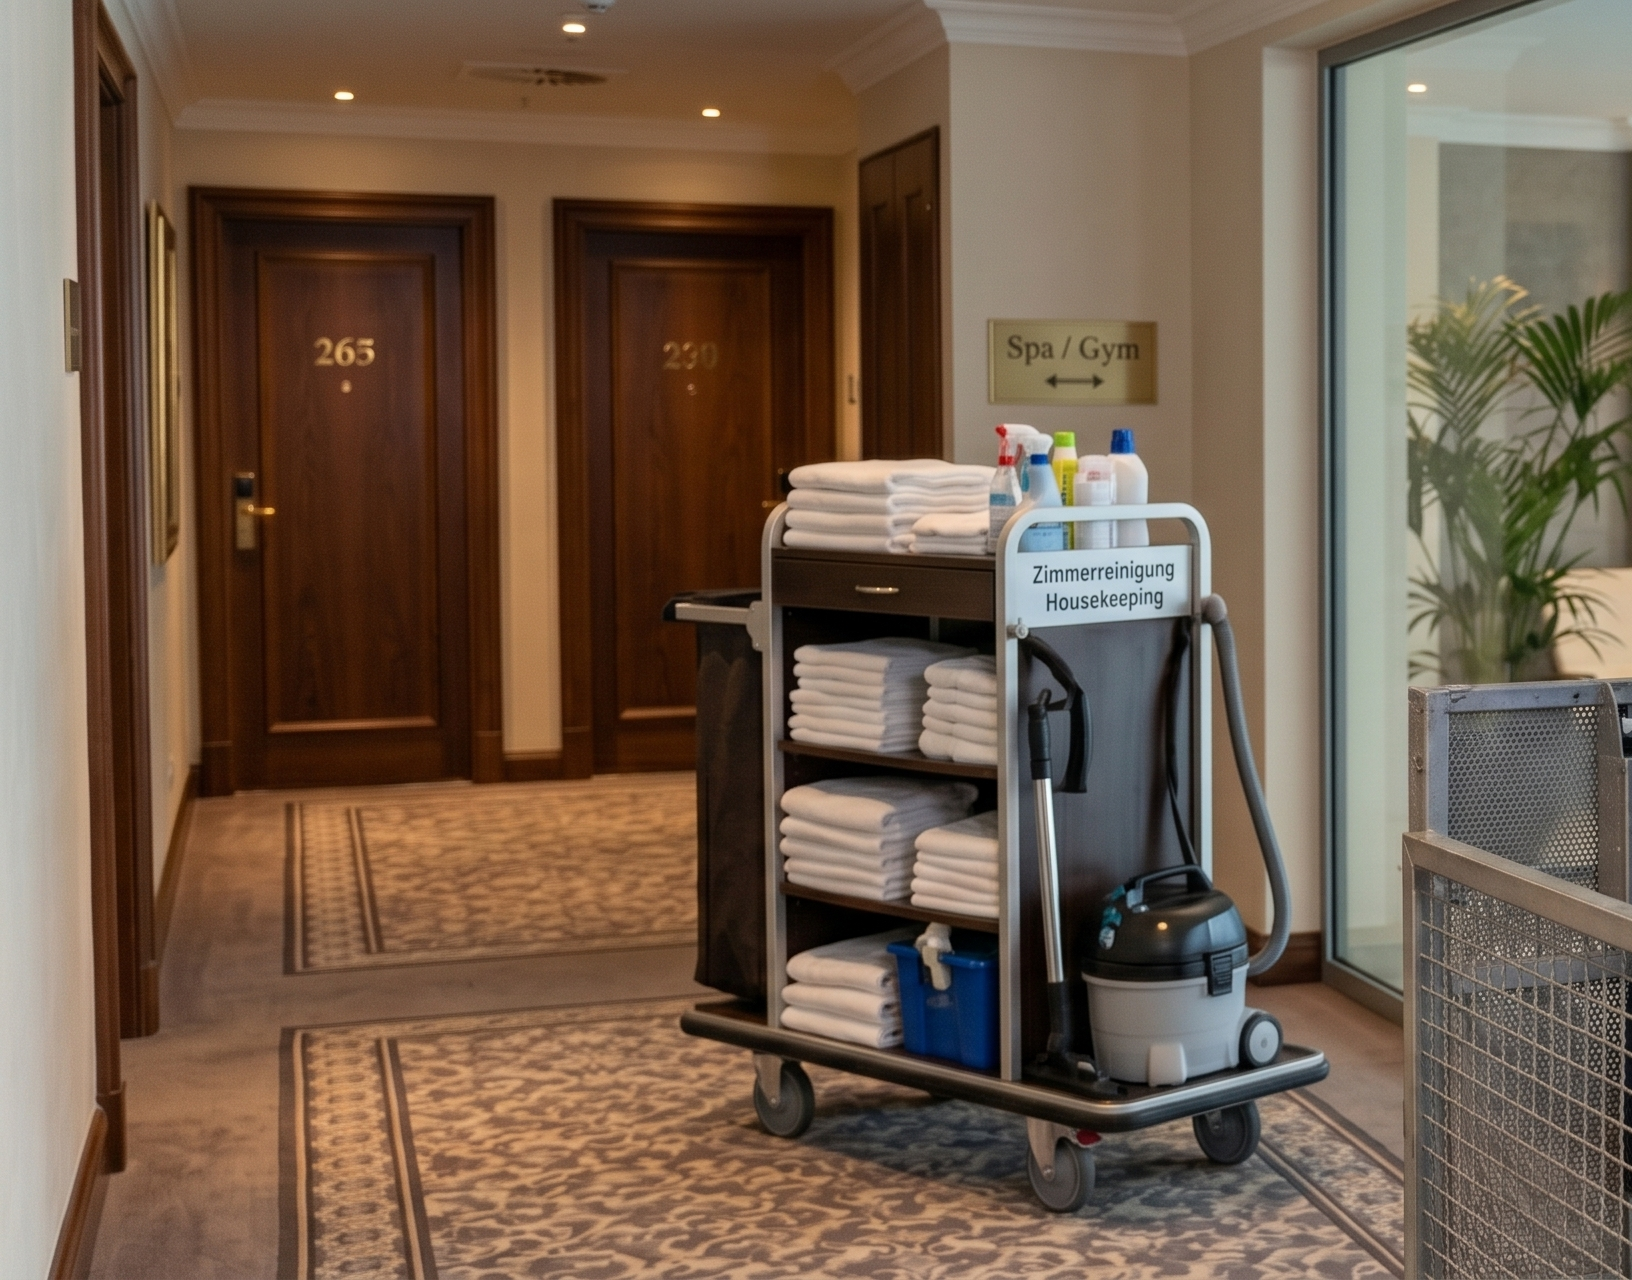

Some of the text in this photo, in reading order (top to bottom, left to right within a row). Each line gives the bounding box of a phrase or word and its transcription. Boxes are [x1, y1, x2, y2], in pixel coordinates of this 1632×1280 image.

[314, 337, 375, 367] 265
[1007, 334, 1140, 367] Spa / Gym
[1033, 560, 1175, 584] Zimmerreinigung
[1046, 587, 1164, 612] Housekeeping
